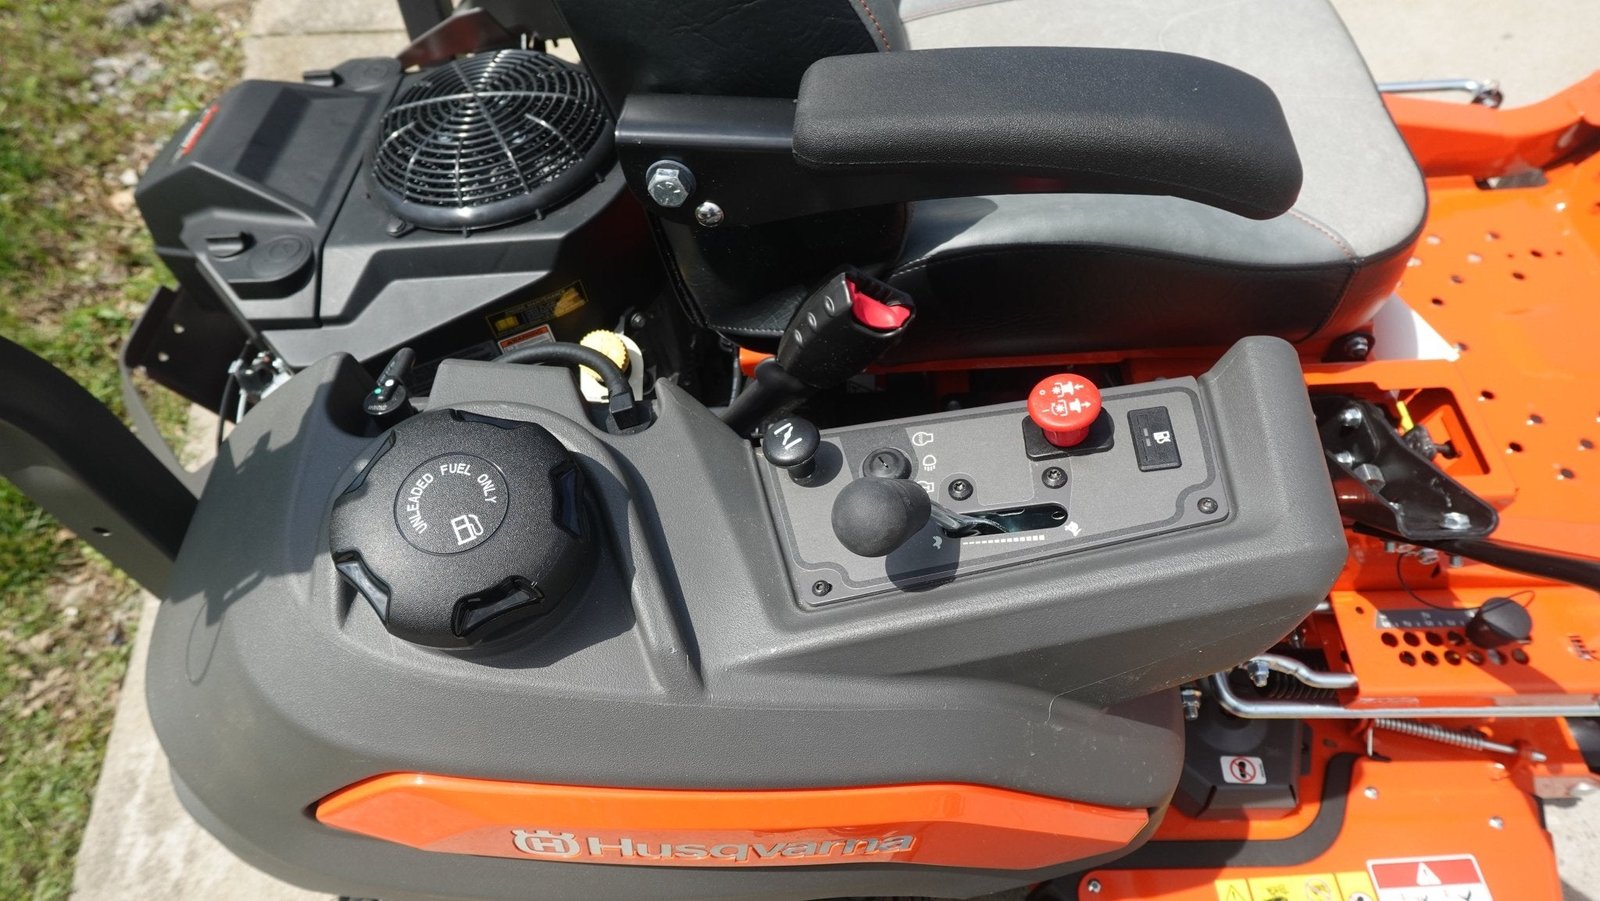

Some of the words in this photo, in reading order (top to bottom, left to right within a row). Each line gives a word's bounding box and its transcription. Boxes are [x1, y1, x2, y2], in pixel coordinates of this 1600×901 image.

[407, 473, 434, 534] UNLEADED
[440, 463, 471, 476] FUEL
[477, 474, 497, 504] ONLY
[586, 832, 916, 862] Husqvarna
